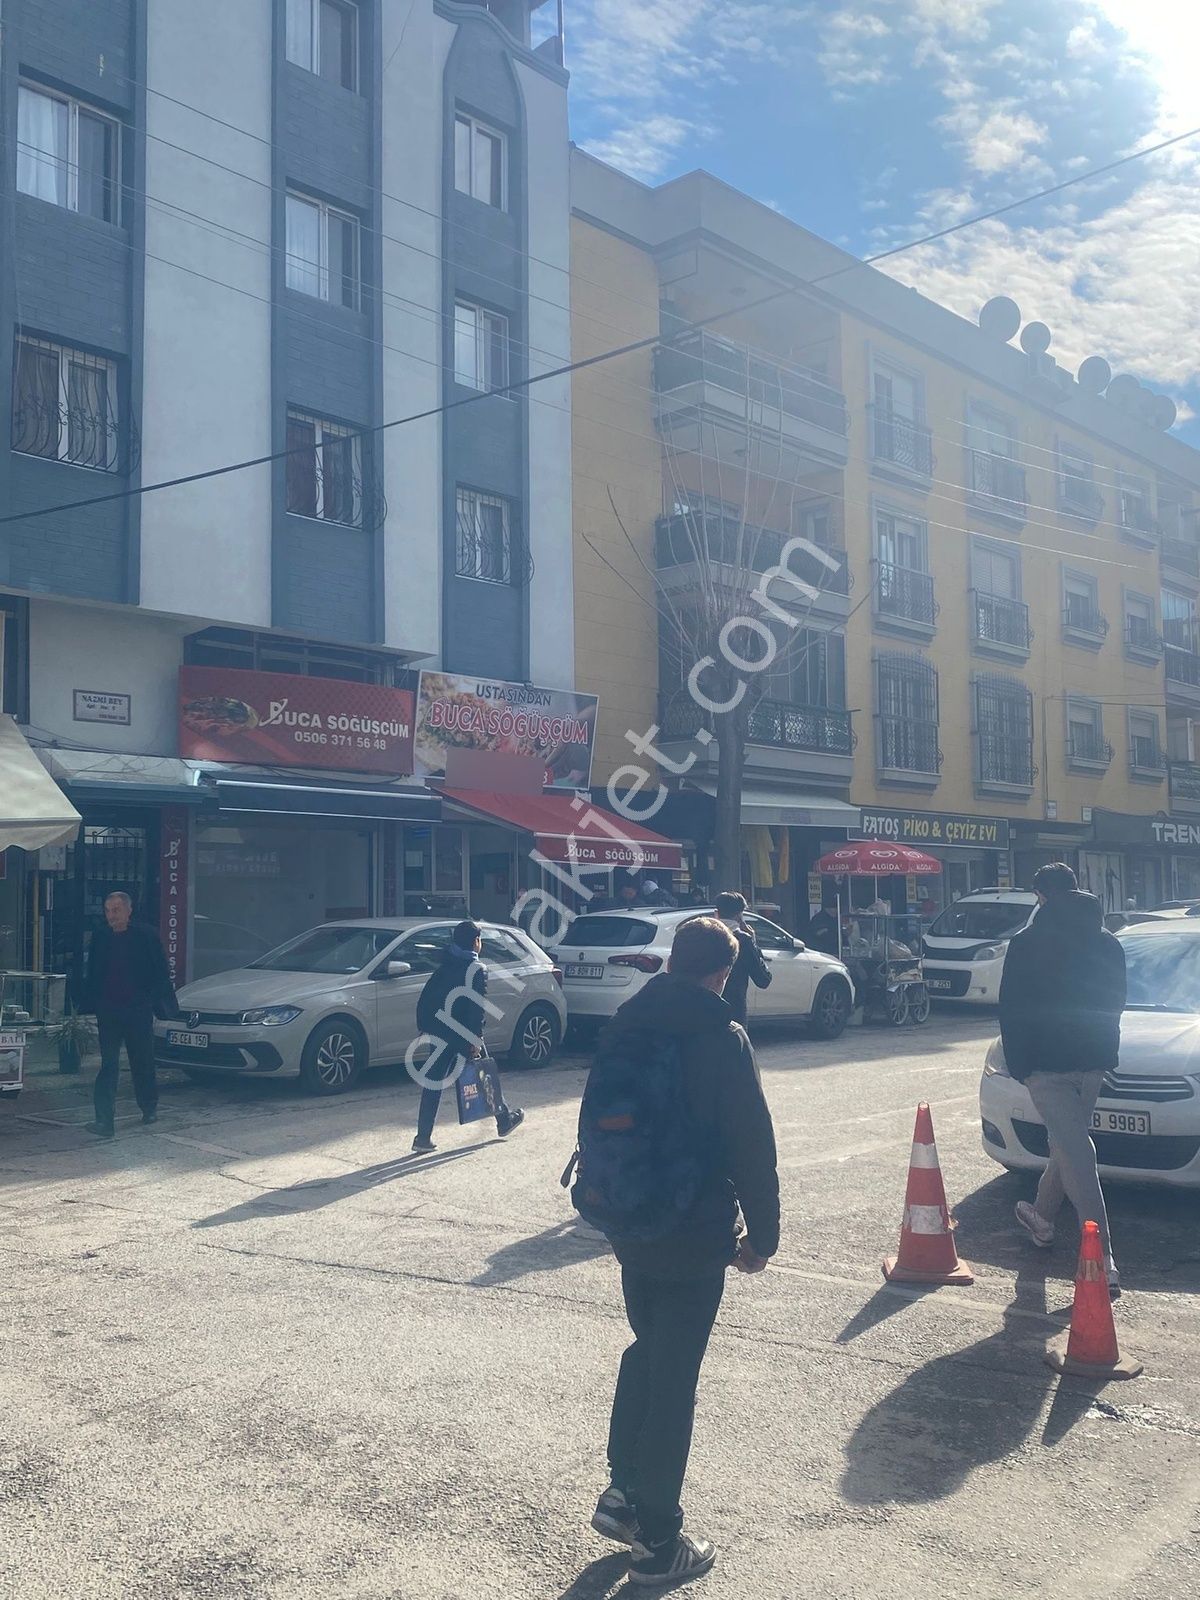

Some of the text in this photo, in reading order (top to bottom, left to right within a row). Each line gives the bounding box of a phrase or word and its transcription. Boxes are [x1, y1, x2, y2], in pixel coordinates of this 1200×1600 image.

[259, 698, 322, 729] BUCA
[427, 699, 589, 747] BUCA SÖĞÜŞÇÜM
[294, 731, 387, 750] 0506 371 56 48
[862, 815, 900, 841] FATOŞ
[903, 814, 930, 837] PİKO
[931, 822, 942, 838] &
[945, 818, 977, 843] ÇEYİZ
[979, 821, 998, 842] EVİ
[564, 843, 596, 859] BUCA
[1109, 1113, 1146, 1133] 9983
